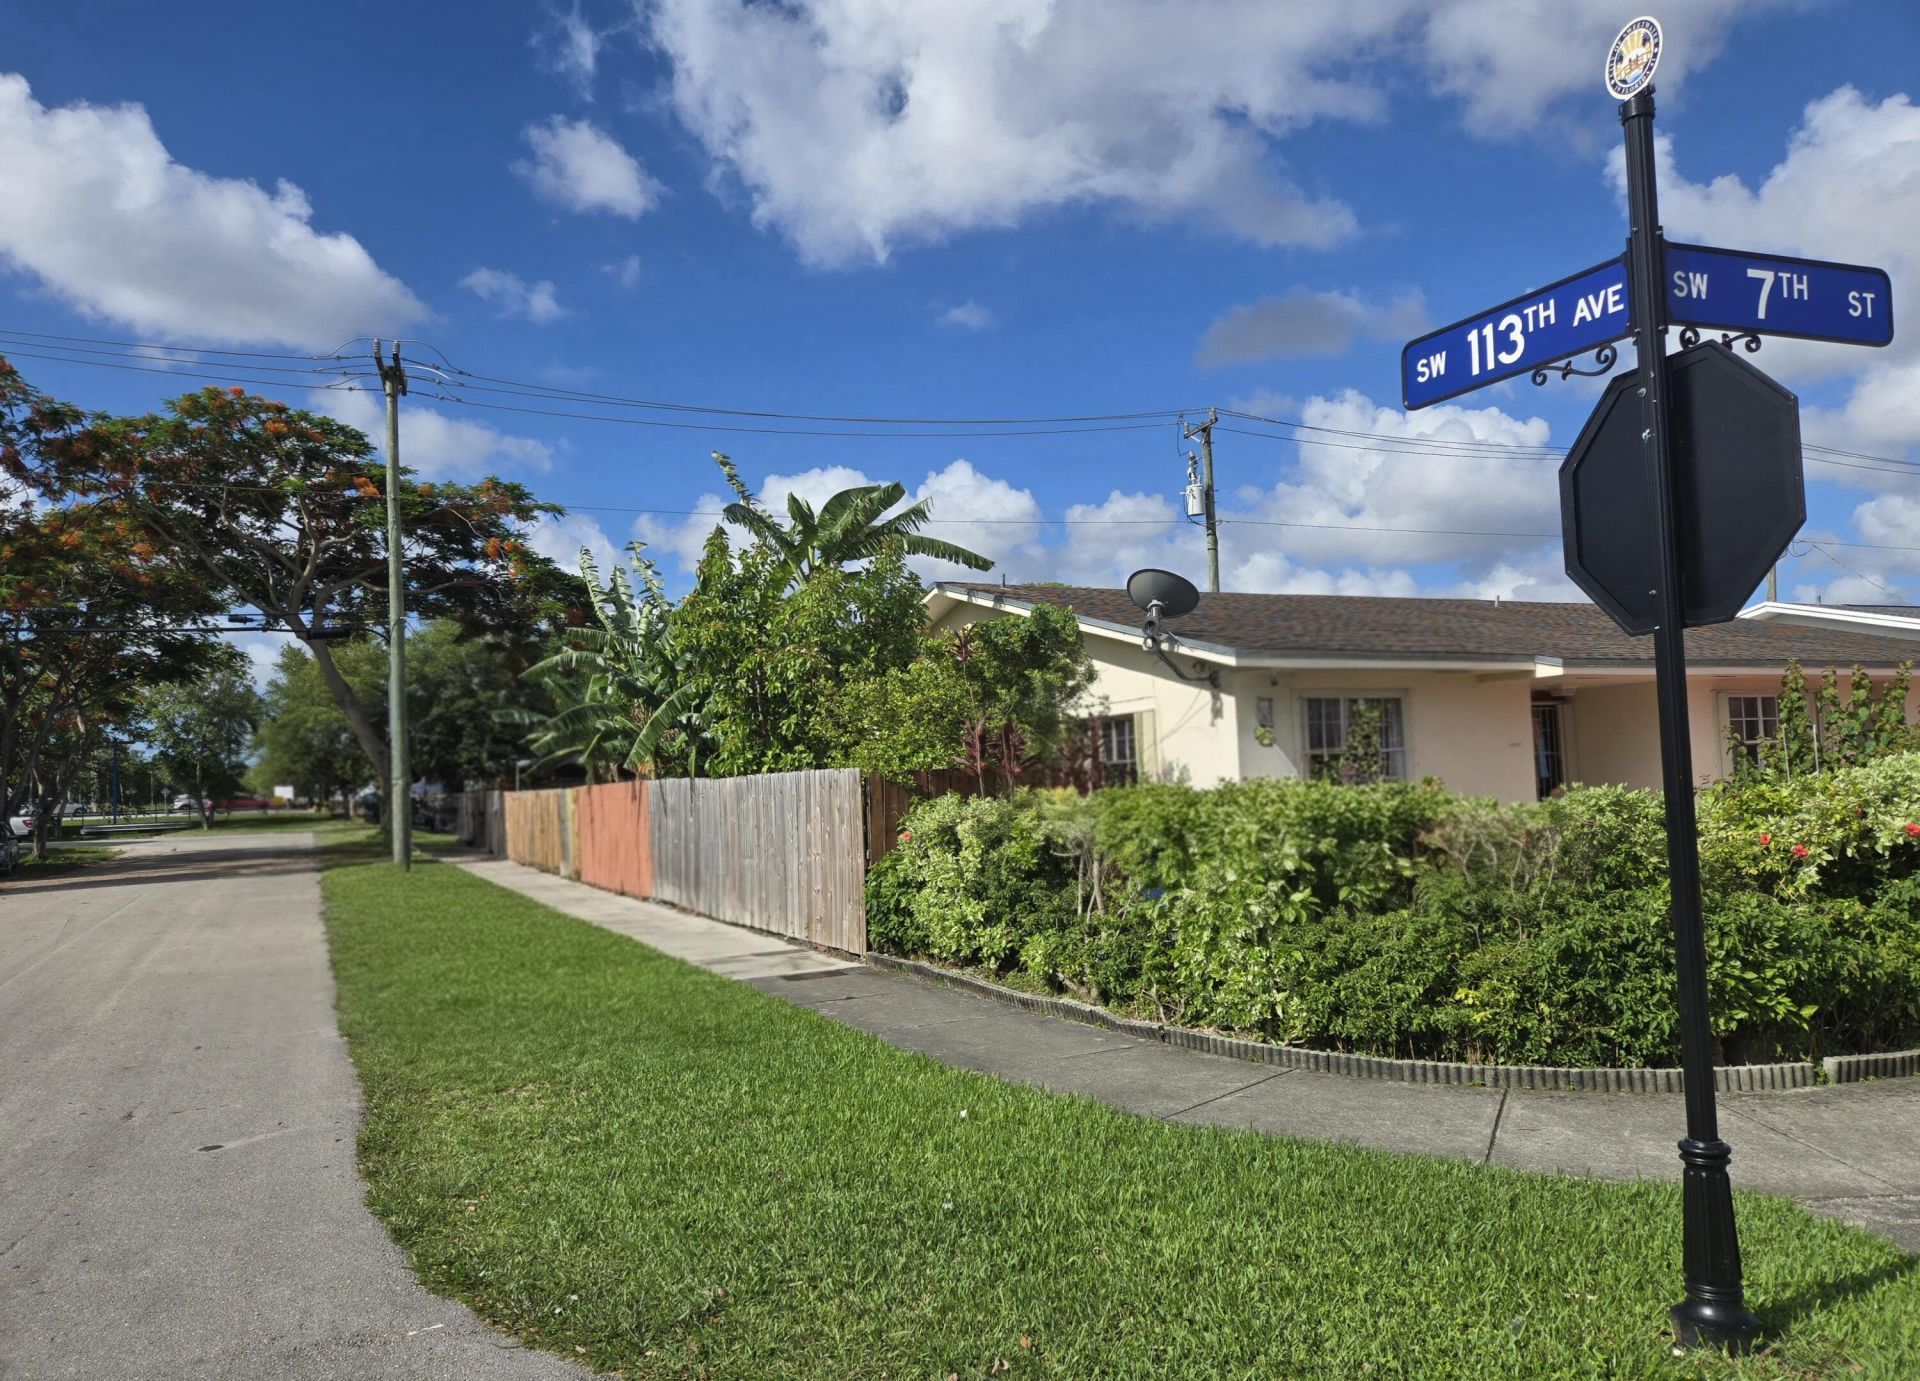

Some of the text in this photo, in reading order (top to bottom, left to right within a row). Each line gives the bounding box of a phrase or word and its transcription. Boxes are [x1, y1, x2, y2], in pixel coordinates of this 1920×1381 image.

[1622, 22, 1659, 42] SWEETWATER
[1621, 71, 1650, 94] FLORIDA
[1673, 268, 1875, 320] SW 7TH ST
[1417, 283, 1625, 383] SW 113TH AVE
